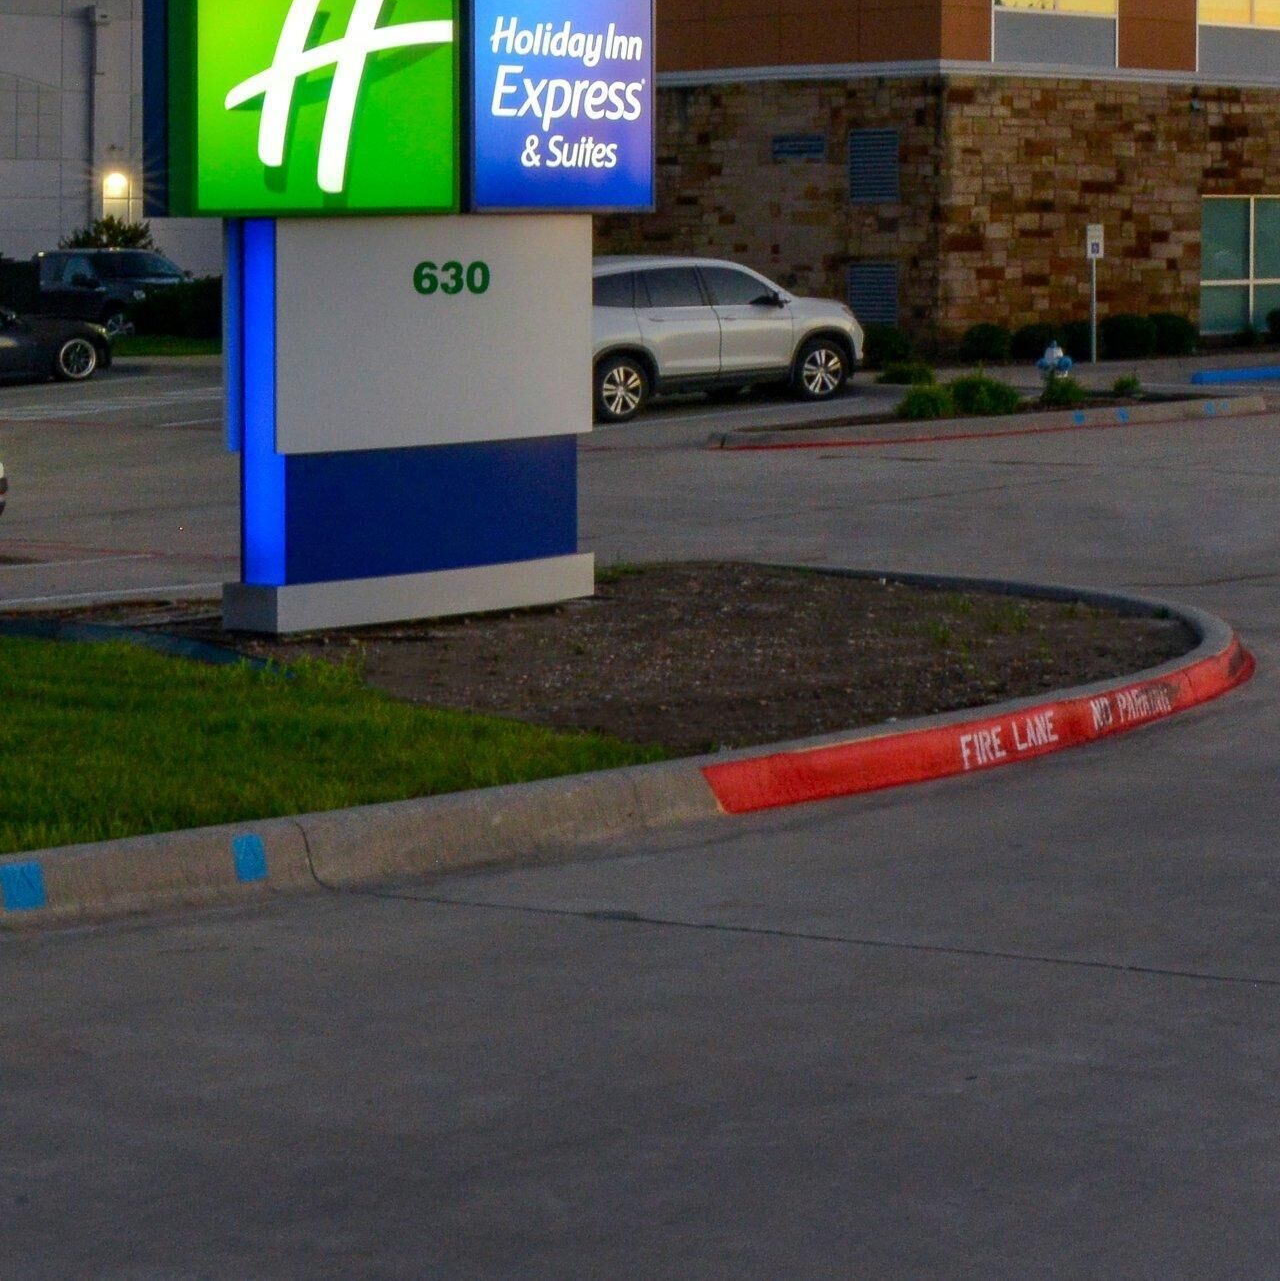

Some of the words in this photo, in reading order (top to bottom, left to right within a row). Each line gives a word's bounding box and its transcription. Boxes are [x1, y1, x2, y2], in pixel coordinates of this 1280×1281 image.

[490, 16, 603, 67] Holiday
[604, 22, 643, 61] Inn
[491, 64, 643, 132] Express
[520, 134, 541, 167] &
[545, 134, 618, 168] Suites
[413, 261, 490, 295] 630
[960, 726, 1007, 769] FIRE
[1011, 711, 1059, 751] LANE
[1090, 697, 1113, 731] NO
